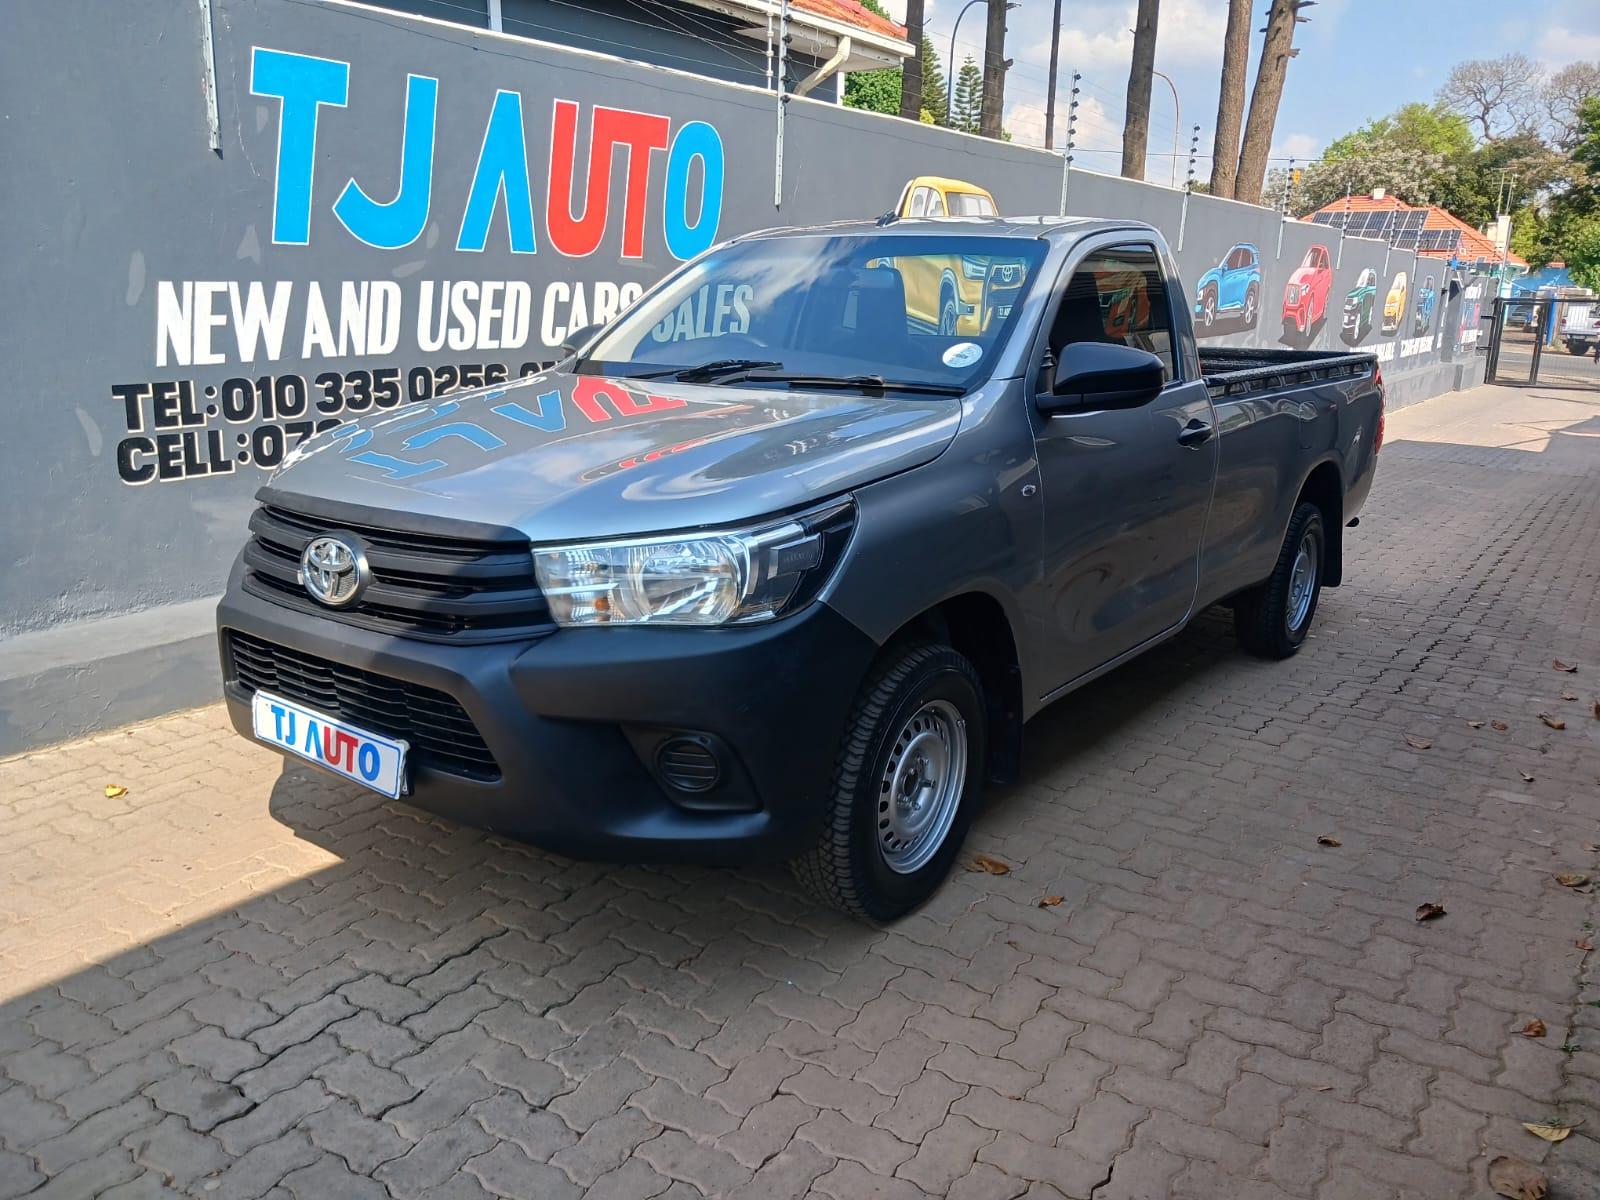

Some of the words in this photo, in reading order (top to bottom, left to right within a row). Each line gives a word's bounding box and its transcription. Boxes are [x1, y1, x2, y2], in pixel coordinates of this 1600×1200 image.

[250, 46, 438, 249] TJ
[455, 89, 724, 261] AUTO
[156, 281, 292, 366] NEW
[302, 281, 401, 359] AND
[417, 280, 531, 352] USED
[315, 367, 401, 415] 335
[117, 418, 345, 485] CELL:07
[271, 705, 296, 745] TJ
[305, 720, 380, 781] AUTO
